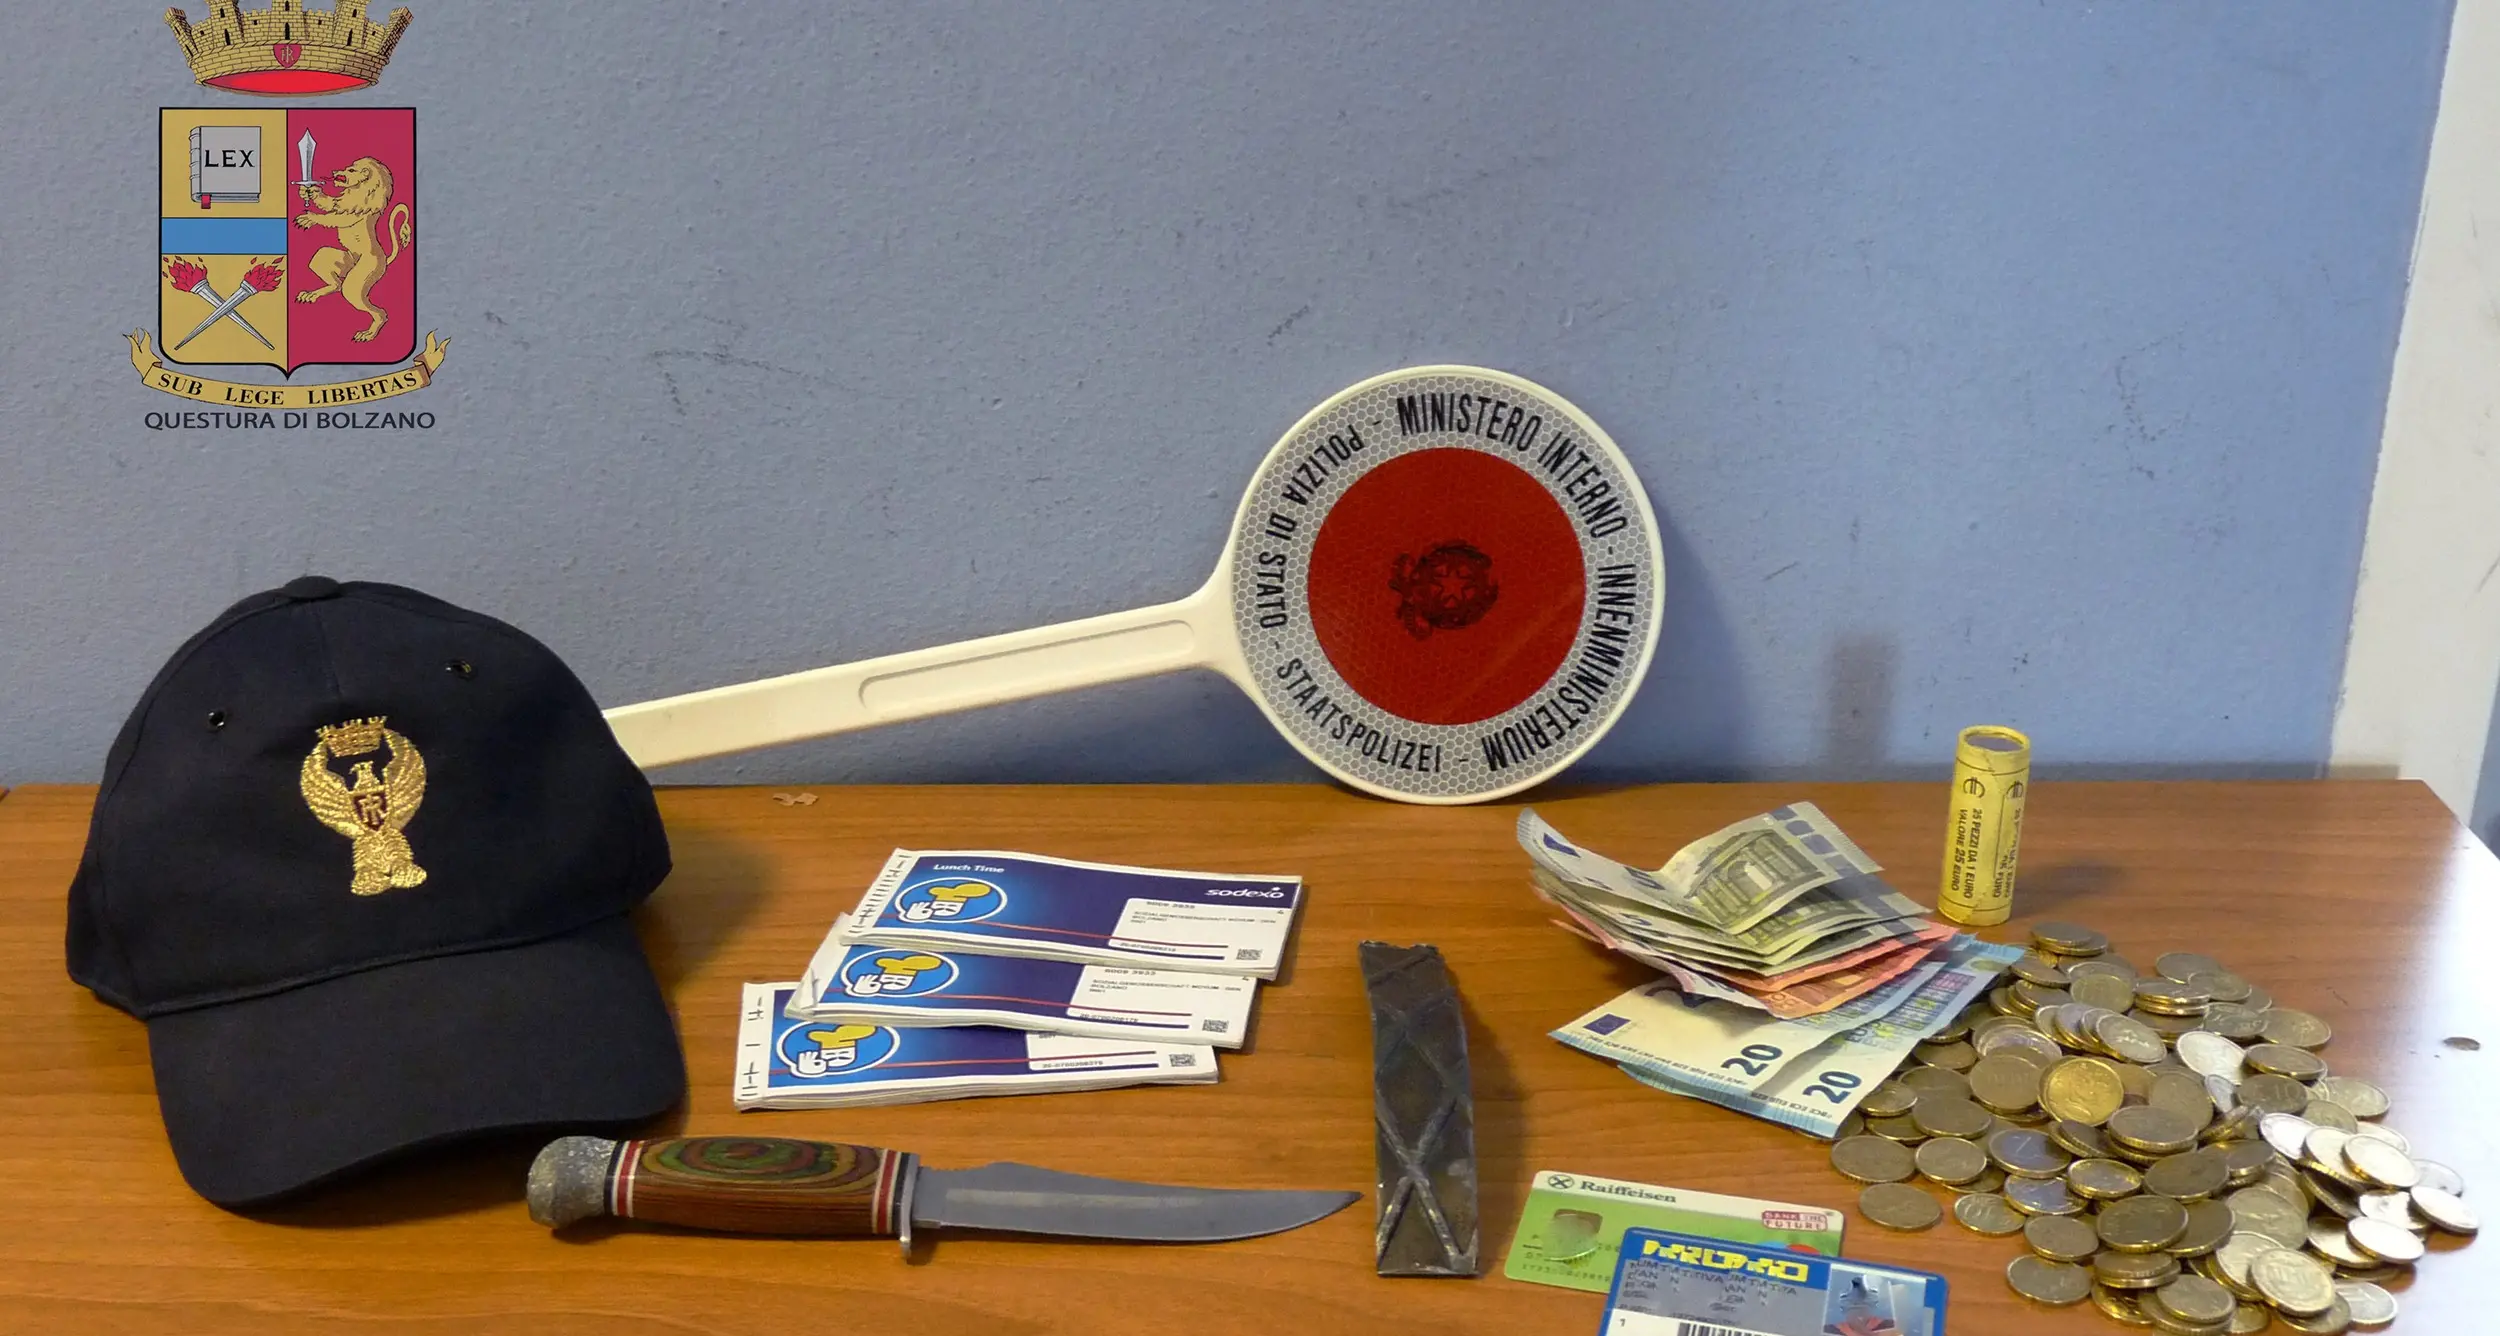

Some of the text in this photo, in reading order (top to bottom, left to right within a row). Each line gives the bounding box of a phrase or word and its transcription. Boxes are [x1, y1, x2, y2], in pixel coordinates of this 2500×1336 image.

[1397, 392, 1629, 540] MINISTERO INTERNO
[1257, 424, 1364, 630] POLIZIA DI STATO
[1481, 563, 1637, 772] INNENMINISTERIUM
[1277, 657, 1442, 773] STAATSPOLIZEI
[1952, 808, 1968, 892] VALORE 25 EURO
[1969, 820, 1982, 848] PEZZI
[932, 863, 1005, 873] Lunch Time
[1967, 849, 1979, 865] DA
[1204, 886, 1284, 899] sodexo
[1964, 872, 1976, 899] EURO
[1720, 1044, 1783, 1077] 20
[1802, 1071, 1863, 1105] 20
[1580, 1180, 1677, 1203] Raiffeisen
